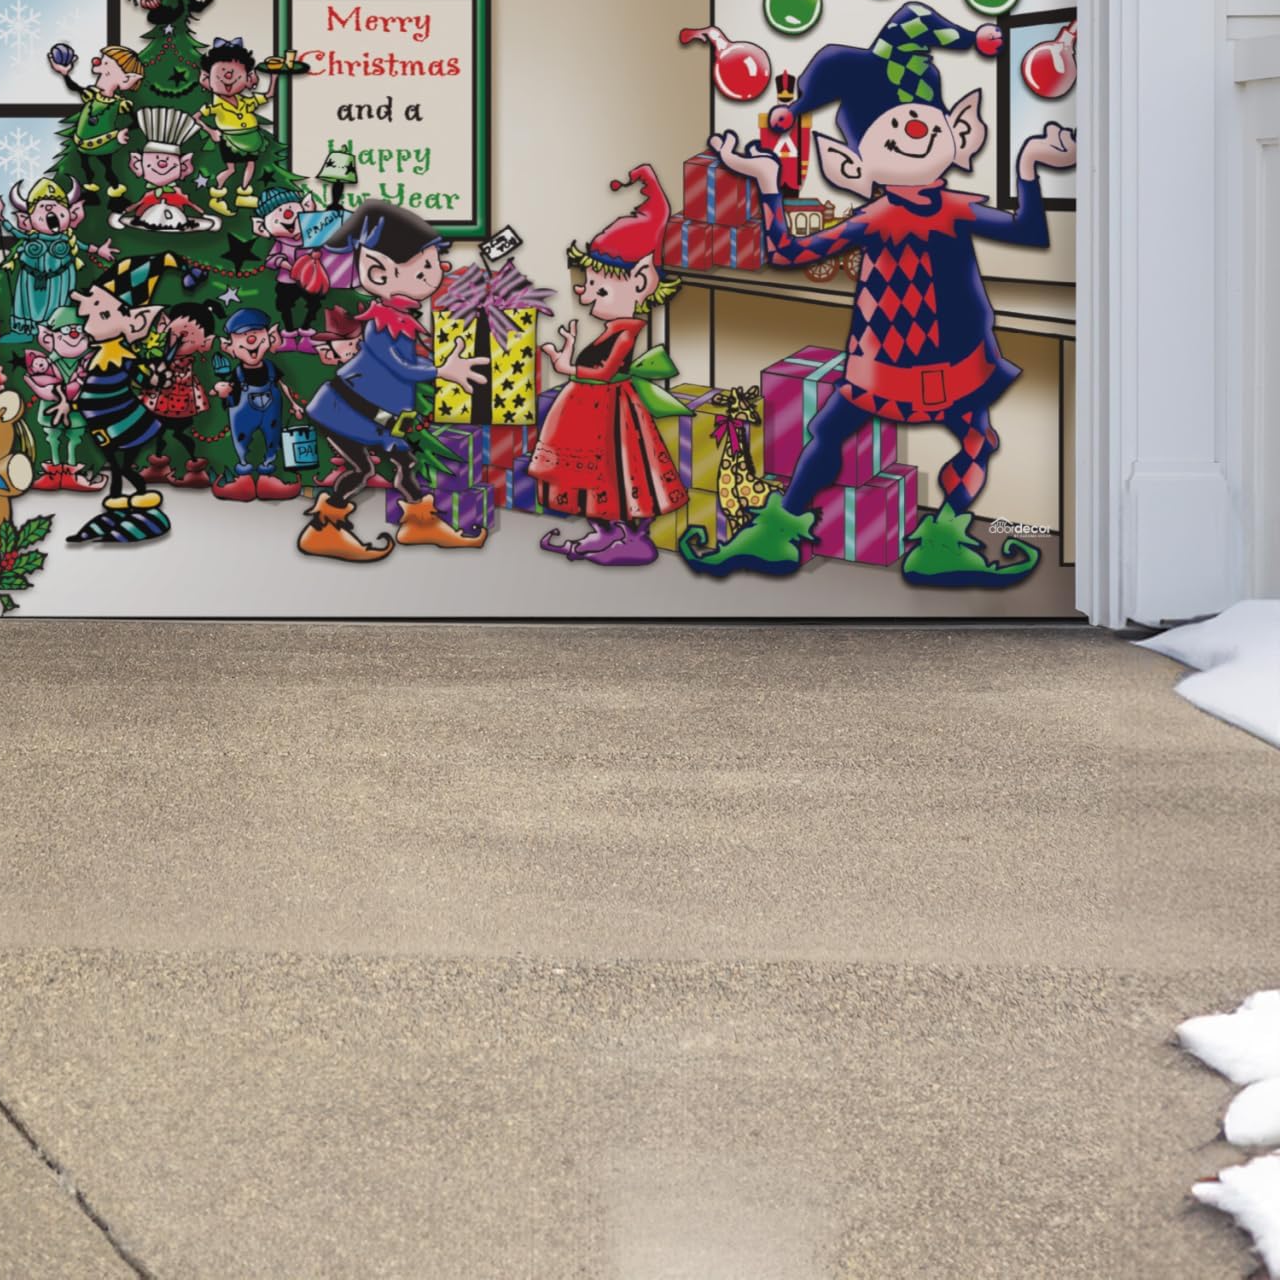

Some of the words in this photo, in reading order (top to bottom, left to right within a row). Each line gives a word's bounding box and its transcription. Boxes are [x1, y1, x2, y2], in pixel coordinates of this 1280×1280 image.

[326, 5, 432, 42] Merry
[298, 50, 461, 77] Christmas
[336, 95, 394, 123] and
[404, 103, 424, 122] a
[379, 182, 461, 210] Year
